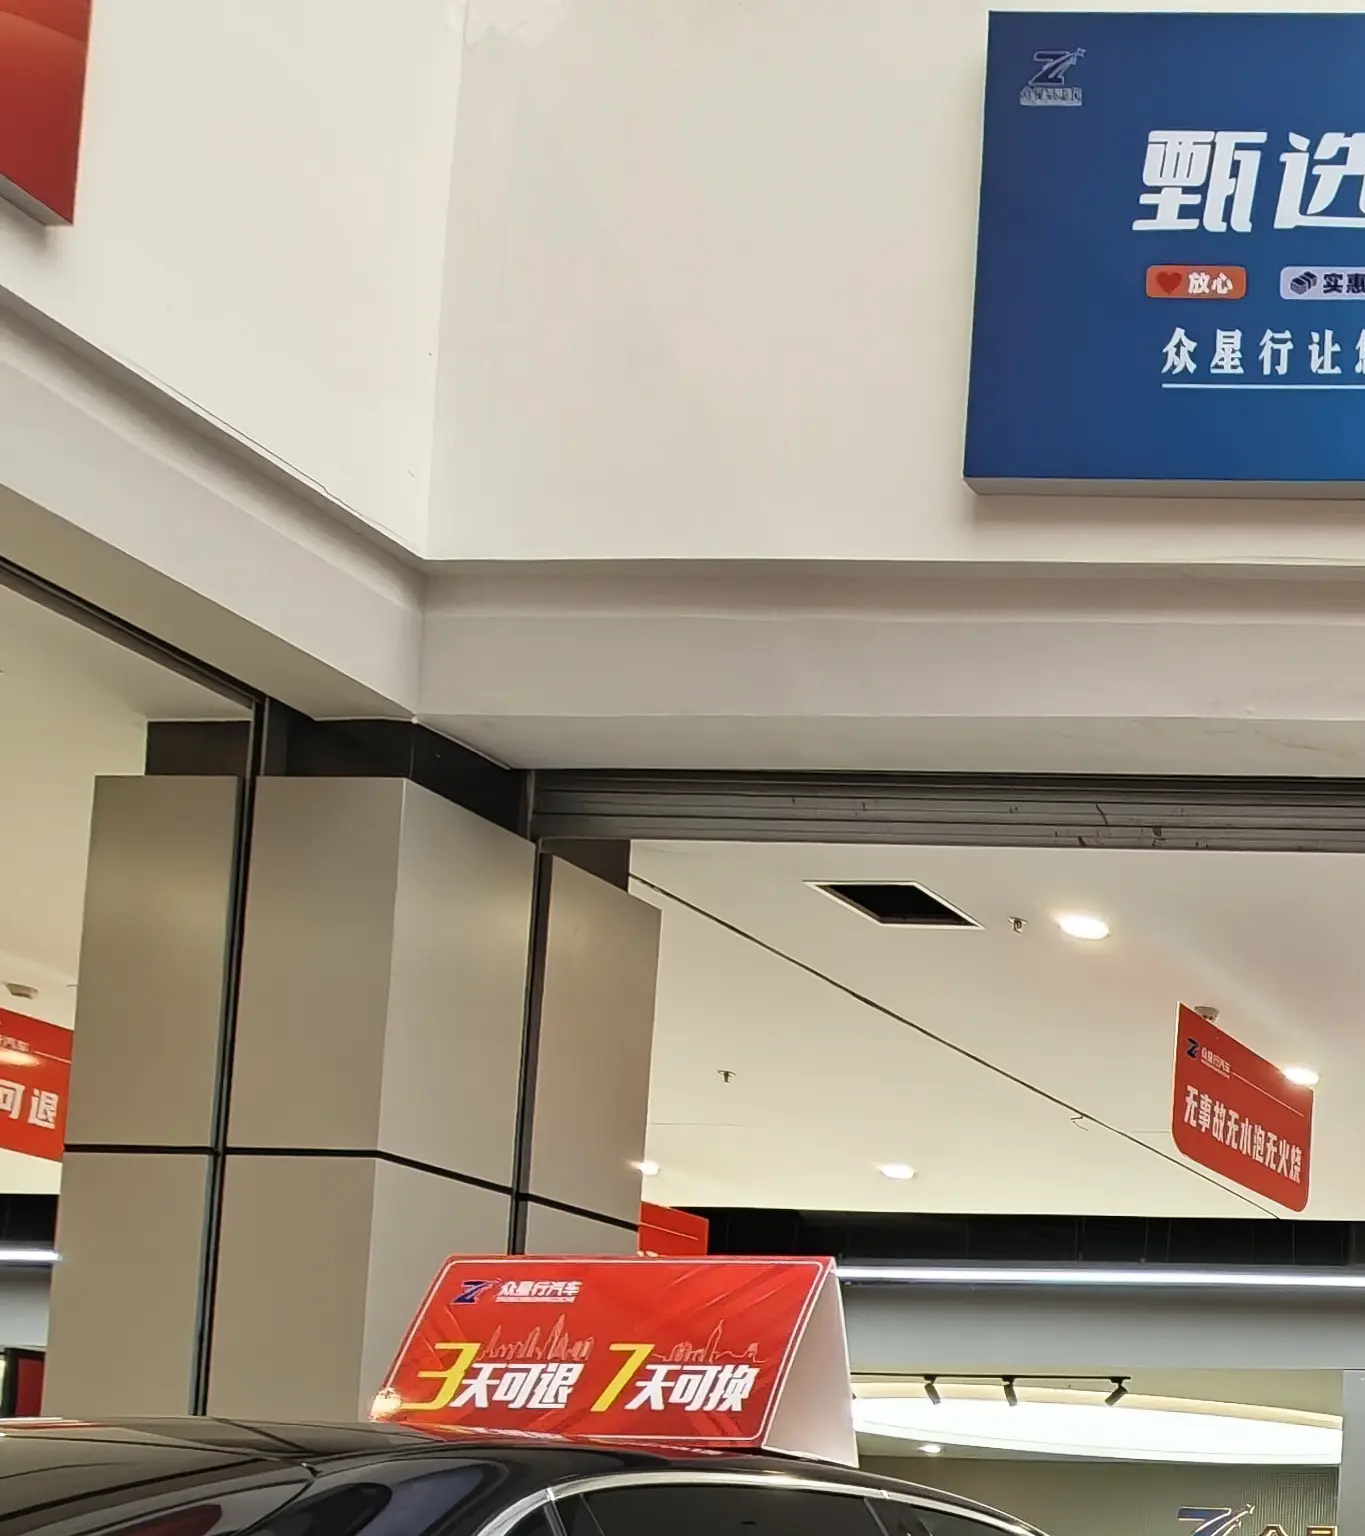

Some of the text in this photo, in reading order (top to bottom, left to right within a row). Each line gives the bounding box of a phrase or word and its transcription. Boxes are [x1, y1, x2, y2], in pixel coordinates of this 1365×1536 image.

[1186, 271, 1234, 296] 放心
[1184, 1084, 1301, 1184] 无事故无水泡无火烧
[397, 1342, 759, 1412] 3天可退 7天可换
